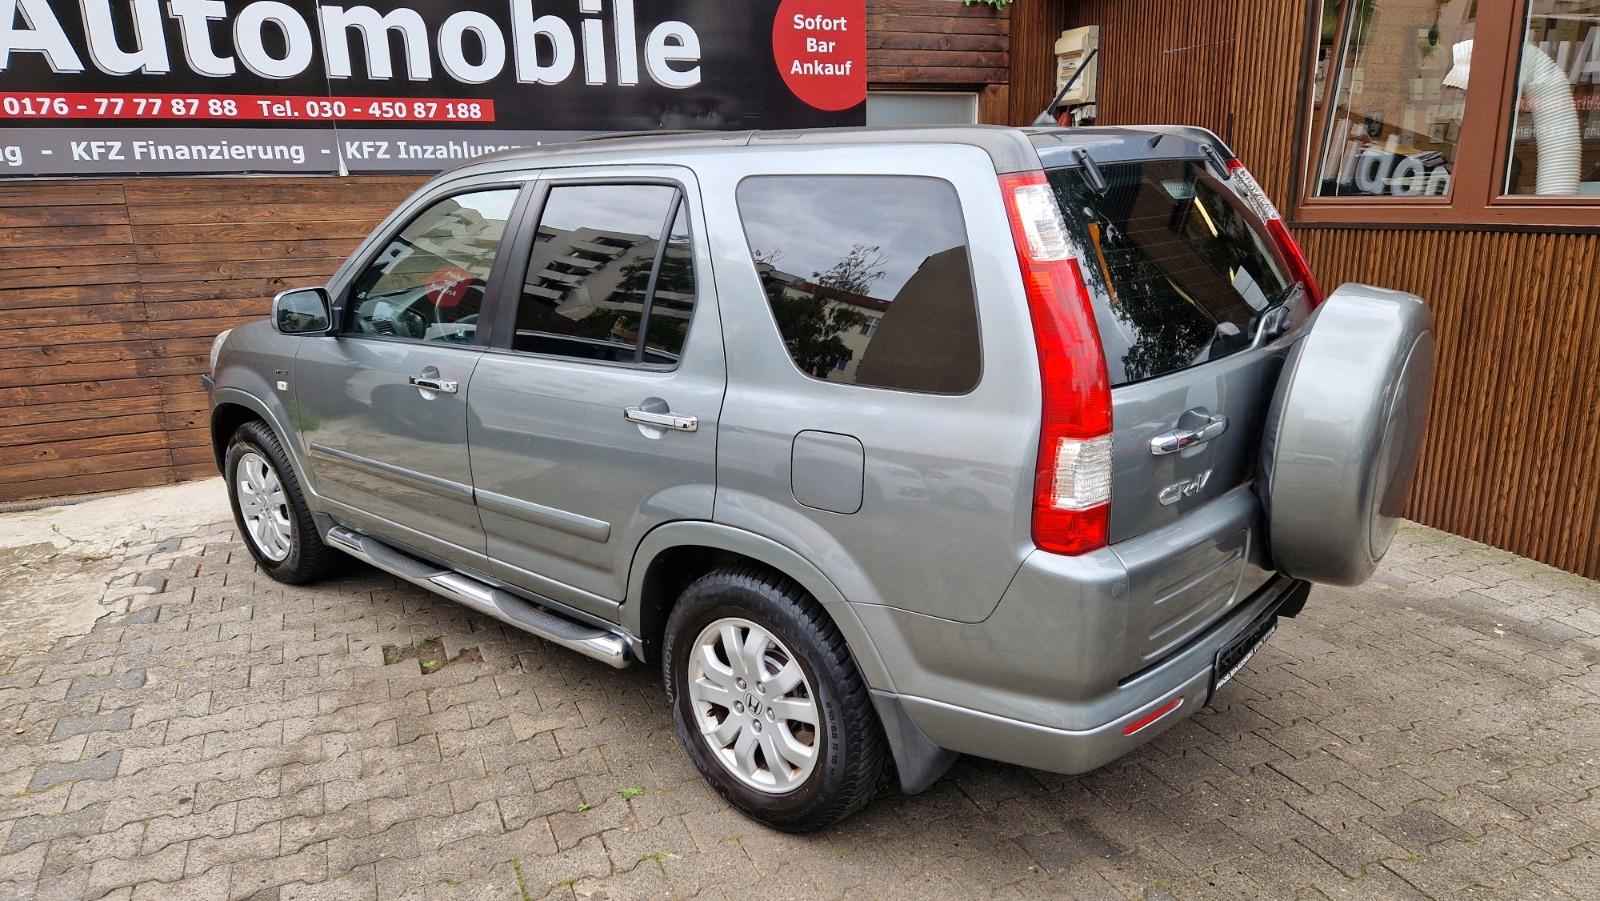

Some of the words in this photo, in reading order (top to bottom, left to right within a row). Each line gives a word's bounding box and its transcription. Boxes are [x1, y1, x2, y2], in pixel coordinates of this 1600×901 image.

[793, 13, 847, 31] Sofort
[0, 0, 703, 89] Automobile
[806, 37, 836, 53] Bar
[790, 59, 852, 76] Ankauf
[3, 97, 69, 115] 0176
[94, 97, 124, 115] 77
[132, 98, 162, 115] 77
[170, 98, 199, 116] 87
[207, 98, 238, 117] 88
[256, 100, 299, 118] Tel.
[305, 100, 347, 118] 030
[368, 101, 407, 118] 450
[413, 102, 438, 118] 87
[445, 102, 482, 119] 188
[70, 141, 125, 161] KFZ
[132, 140, 306, 164] Finanzierung
[345, 141, 391, 160] KFZ
[663, 631, 675, 704] UNIROYA
